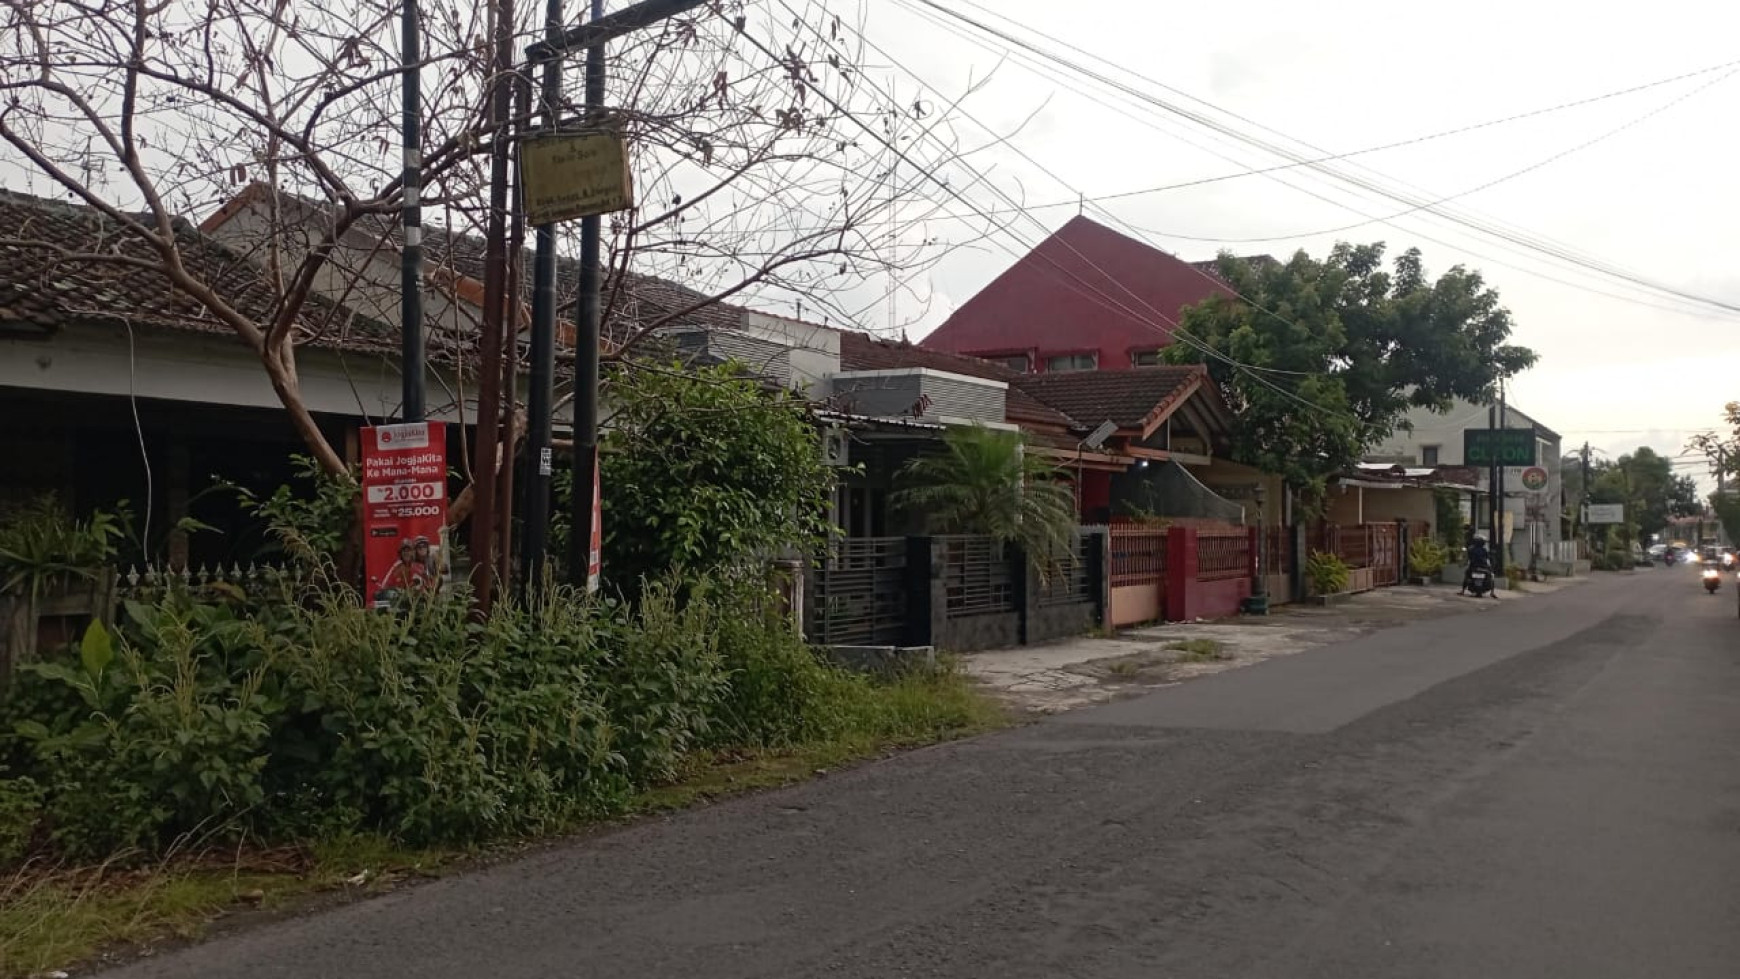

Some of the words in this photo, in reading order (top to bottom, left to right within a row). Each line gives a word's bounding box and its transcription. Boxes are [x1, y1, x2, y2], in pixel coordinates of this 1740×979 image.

[366, 456, 393, 467] Pakai
[396, 453, 442, 466] JogjaKita
[1468, 446, 1529, 461] CLON
[367, 468, 380, 478] Ke
[382, 466, 438, 477] Mana-Mana
[384, 484, 434, 501] 2.000
[398, 506, 439, 517] 25.000
